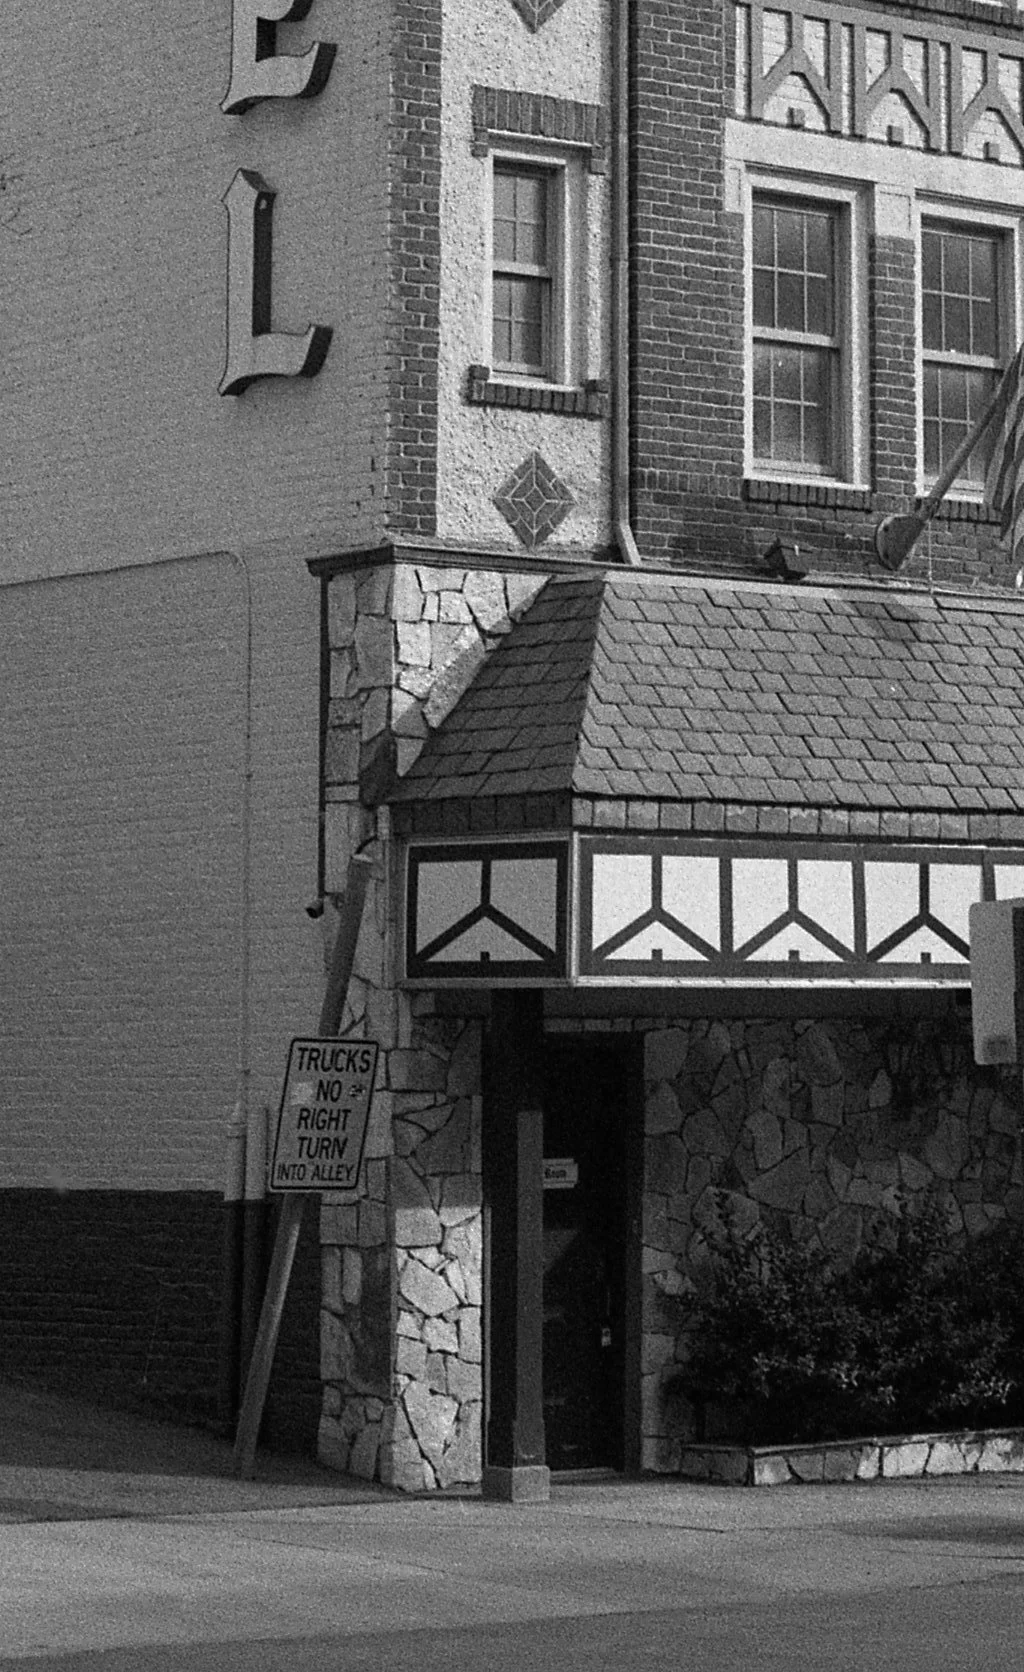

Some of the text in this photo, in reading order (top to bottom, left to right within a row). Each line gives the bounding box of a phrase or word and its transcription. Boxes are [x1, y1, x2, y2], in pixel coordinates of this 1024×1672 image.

[297, 1047, 371, 1073] TRUCKS
[316, 1079, 342, 1103] NO
[297, 1108, 352, 1131] RIGHT
[297, 1136, 349, 1160] TURN
[277, 1164, 355, 1181] INTO ALLEY
